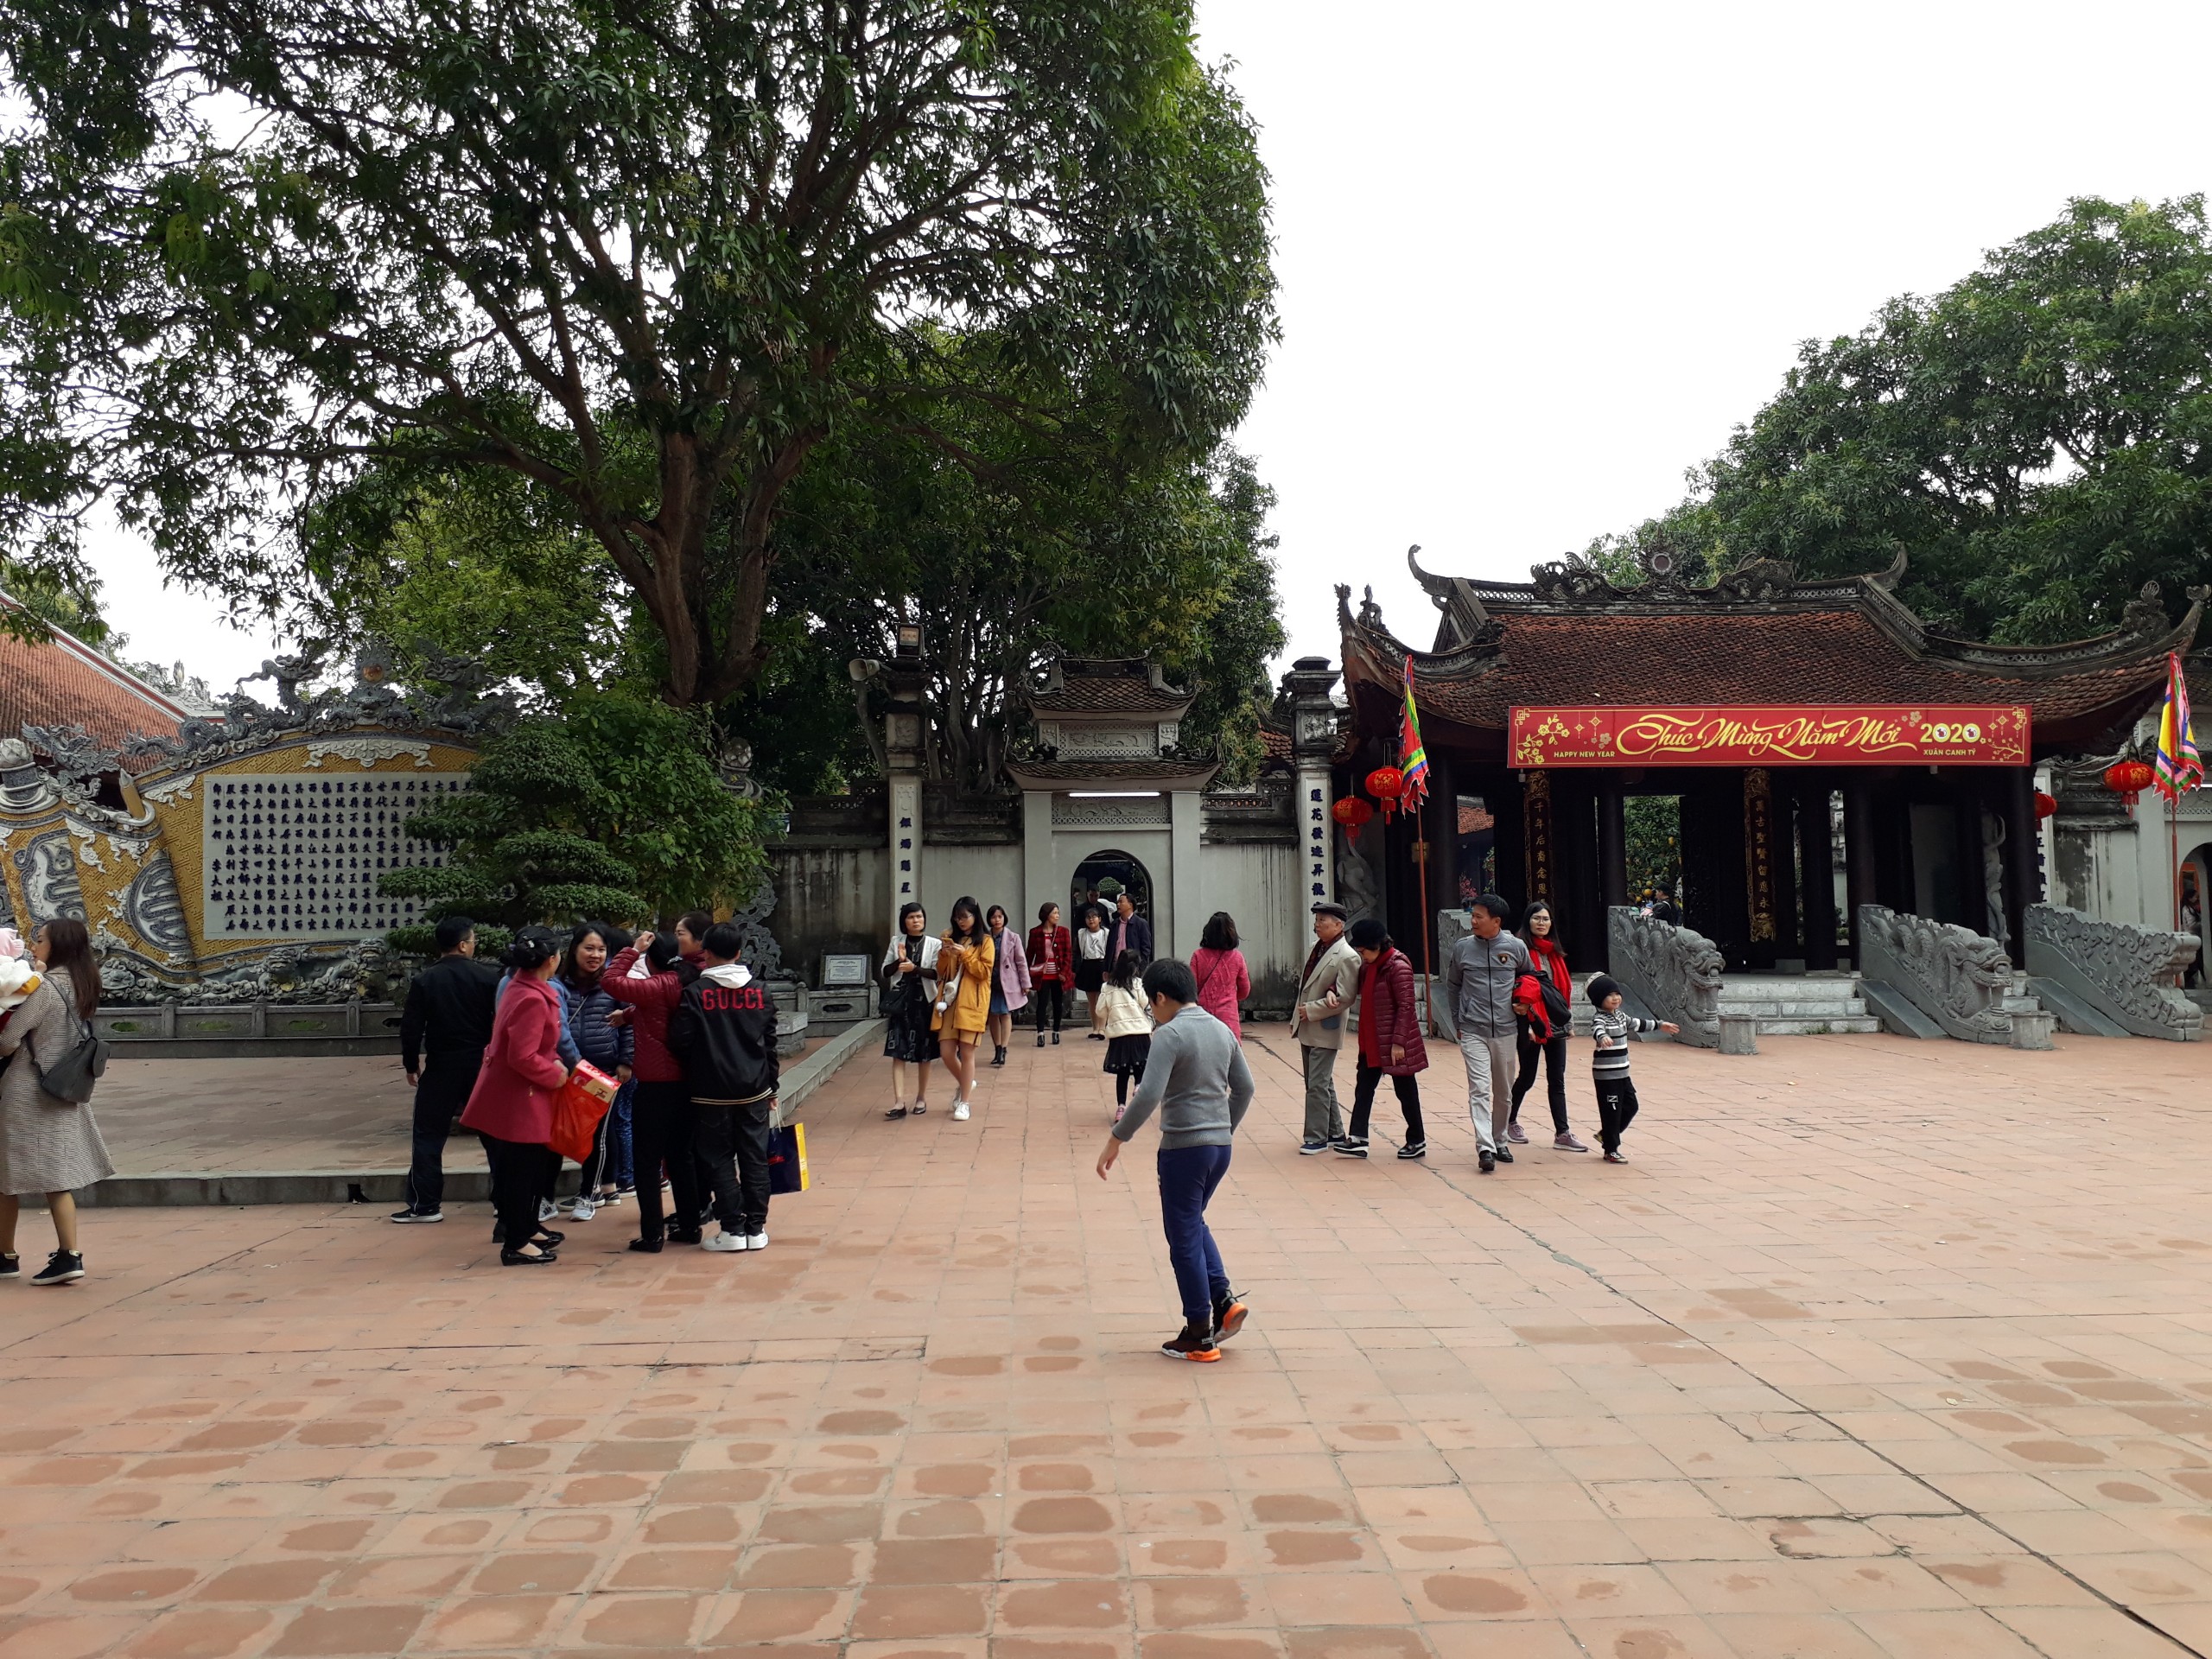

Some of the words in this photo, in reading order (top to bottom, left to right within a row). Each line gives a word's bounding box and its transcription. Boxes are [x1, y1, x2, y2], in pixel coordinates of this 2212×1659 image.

[1617, 712, 1703, 760] Chúc
[1770, 715, 1847, 760] Năm
[1840, 716, 1917, 753] Mới
[1920, 723, 1981, 743] 2020
[702, 988, 765, 1010] GUCCI
